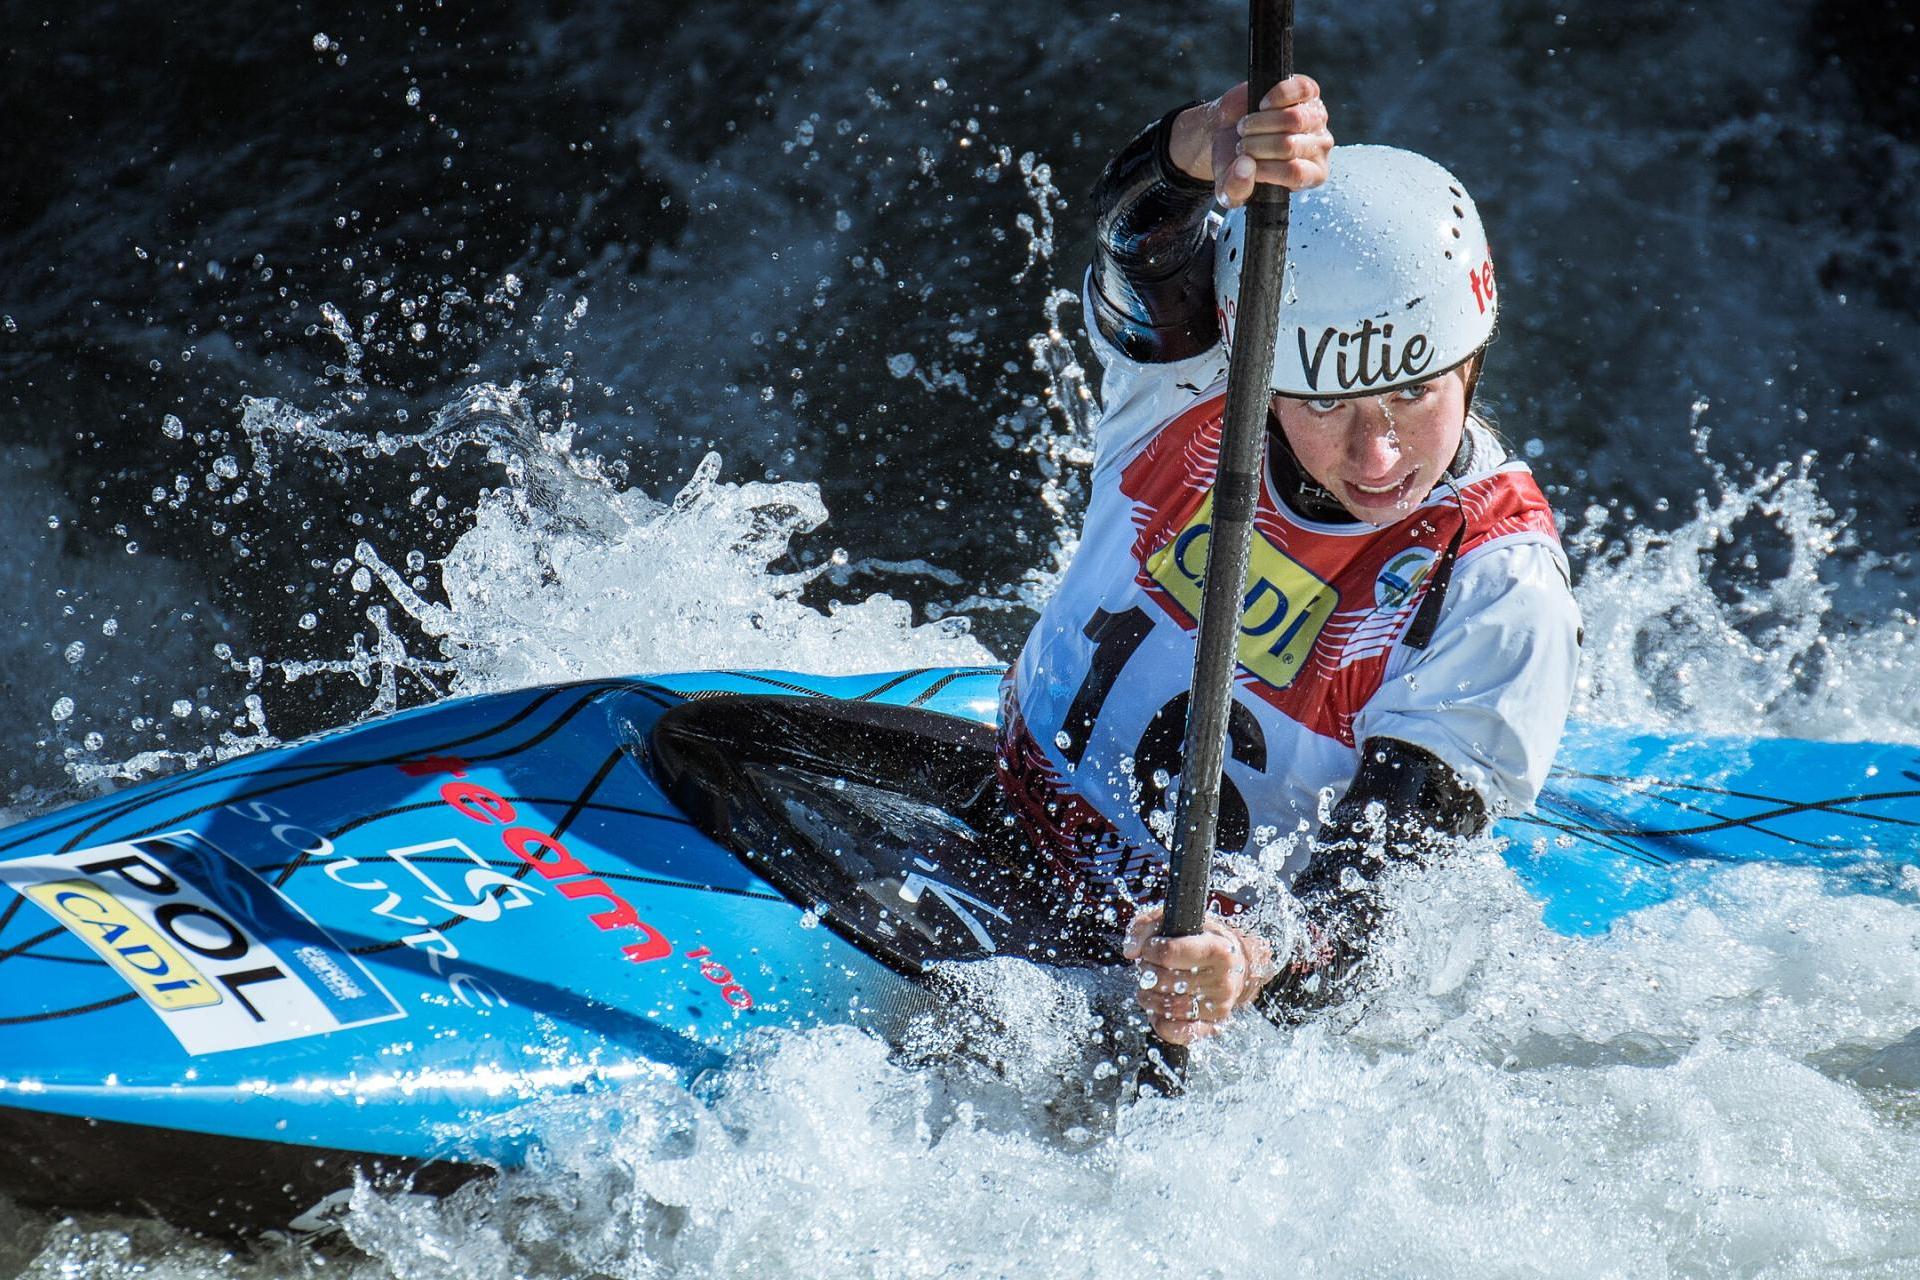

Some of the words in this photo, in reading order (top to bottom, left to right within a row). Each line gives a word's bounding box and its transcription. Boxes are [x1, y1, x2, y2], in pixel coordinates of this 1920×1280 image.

[1298, 319, 1435, 391] Vitie
[1469, 259, 1494, 315] te
[1054, 605, 1267, 856] 16
[77, 855, 287, 1022] POL
[397, 755, 672, 963] team
